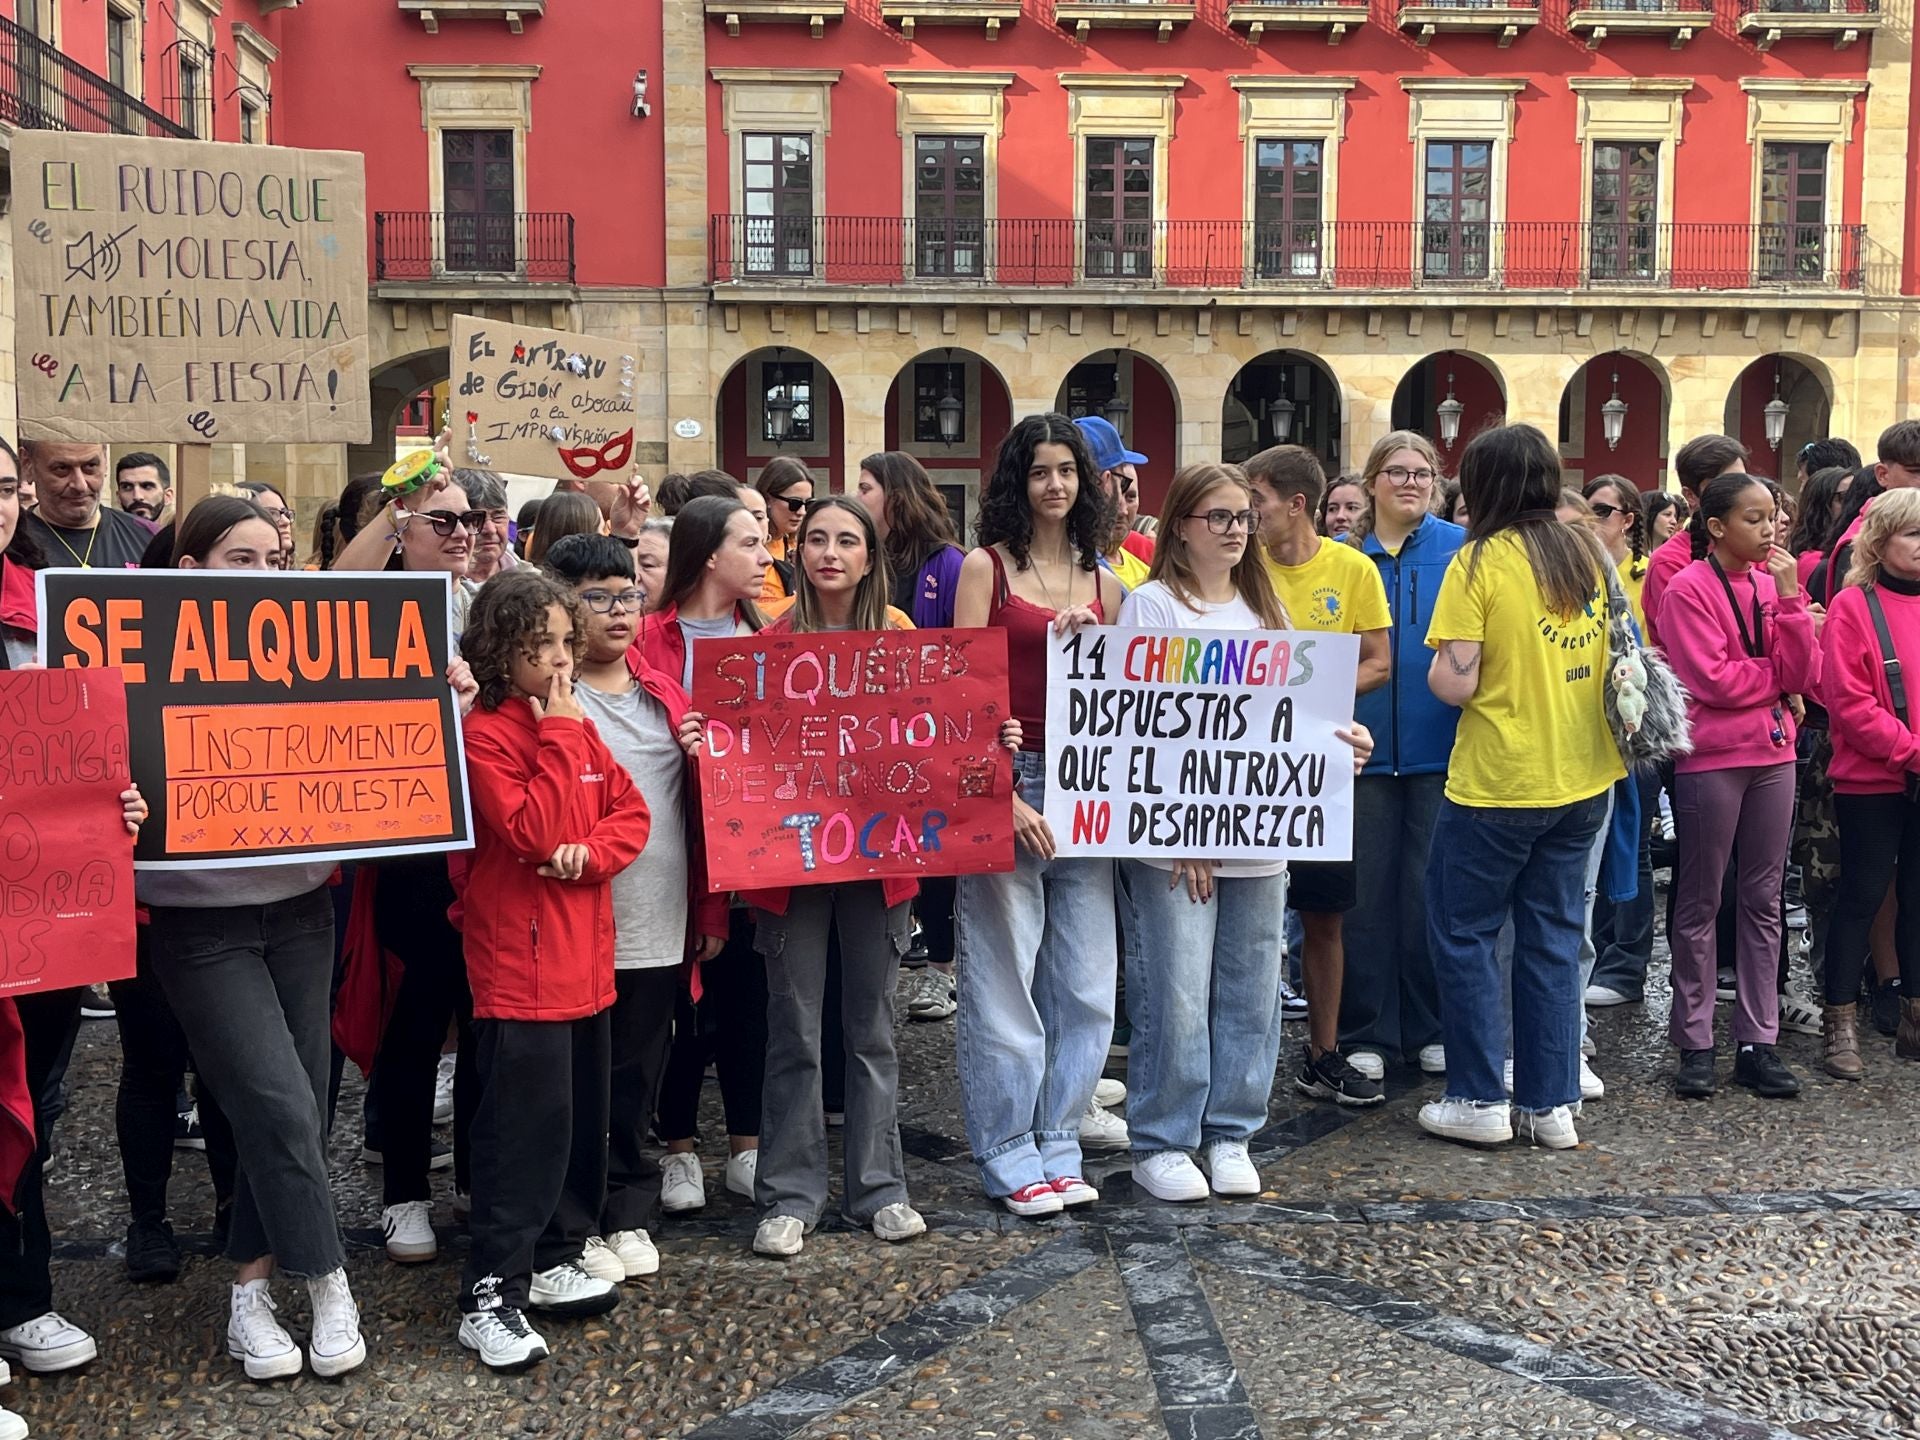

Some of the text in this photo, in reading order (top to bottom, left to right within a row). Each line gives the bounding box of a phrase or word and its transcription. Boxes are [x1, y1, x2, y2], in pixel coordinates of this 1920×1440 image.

[43, 161, 334, 228] EL RUIDO QUE
[138, 236, 314, 286] MOLESTA,
[40, 289, 350, 340] TAMBIÉN DA VIDA
[58, 361, 339, 412] A LA FIESTA!
[459, 371, 486, 396] de
[484, 421, 620, 450] IMPRVISACIÓN
[529, 407, 541, 420] a
[62, 597, 434, 689] SE ALQUILA
[1537, 616, 1559, 643] LOS
[1062, 632, 1316, 687] 14 CHARANGAS
[1565, 664, 1591, 684] GIJÓN
[1069, 687, 1293, 742] DISPUESTAS A
[175, 714, 438, 774] INSTRUMENTO
[712, 757, 934, 807] DEJARNOS
[1058, 744, 1326, 797] QUE EL ANTROXU
[176, 778, 436, 821] PORQUE MOLESTA
[1072, 799, 1324, 848] NO DESAPAREZCA
[782, 809, 948, 872] TOCAR
